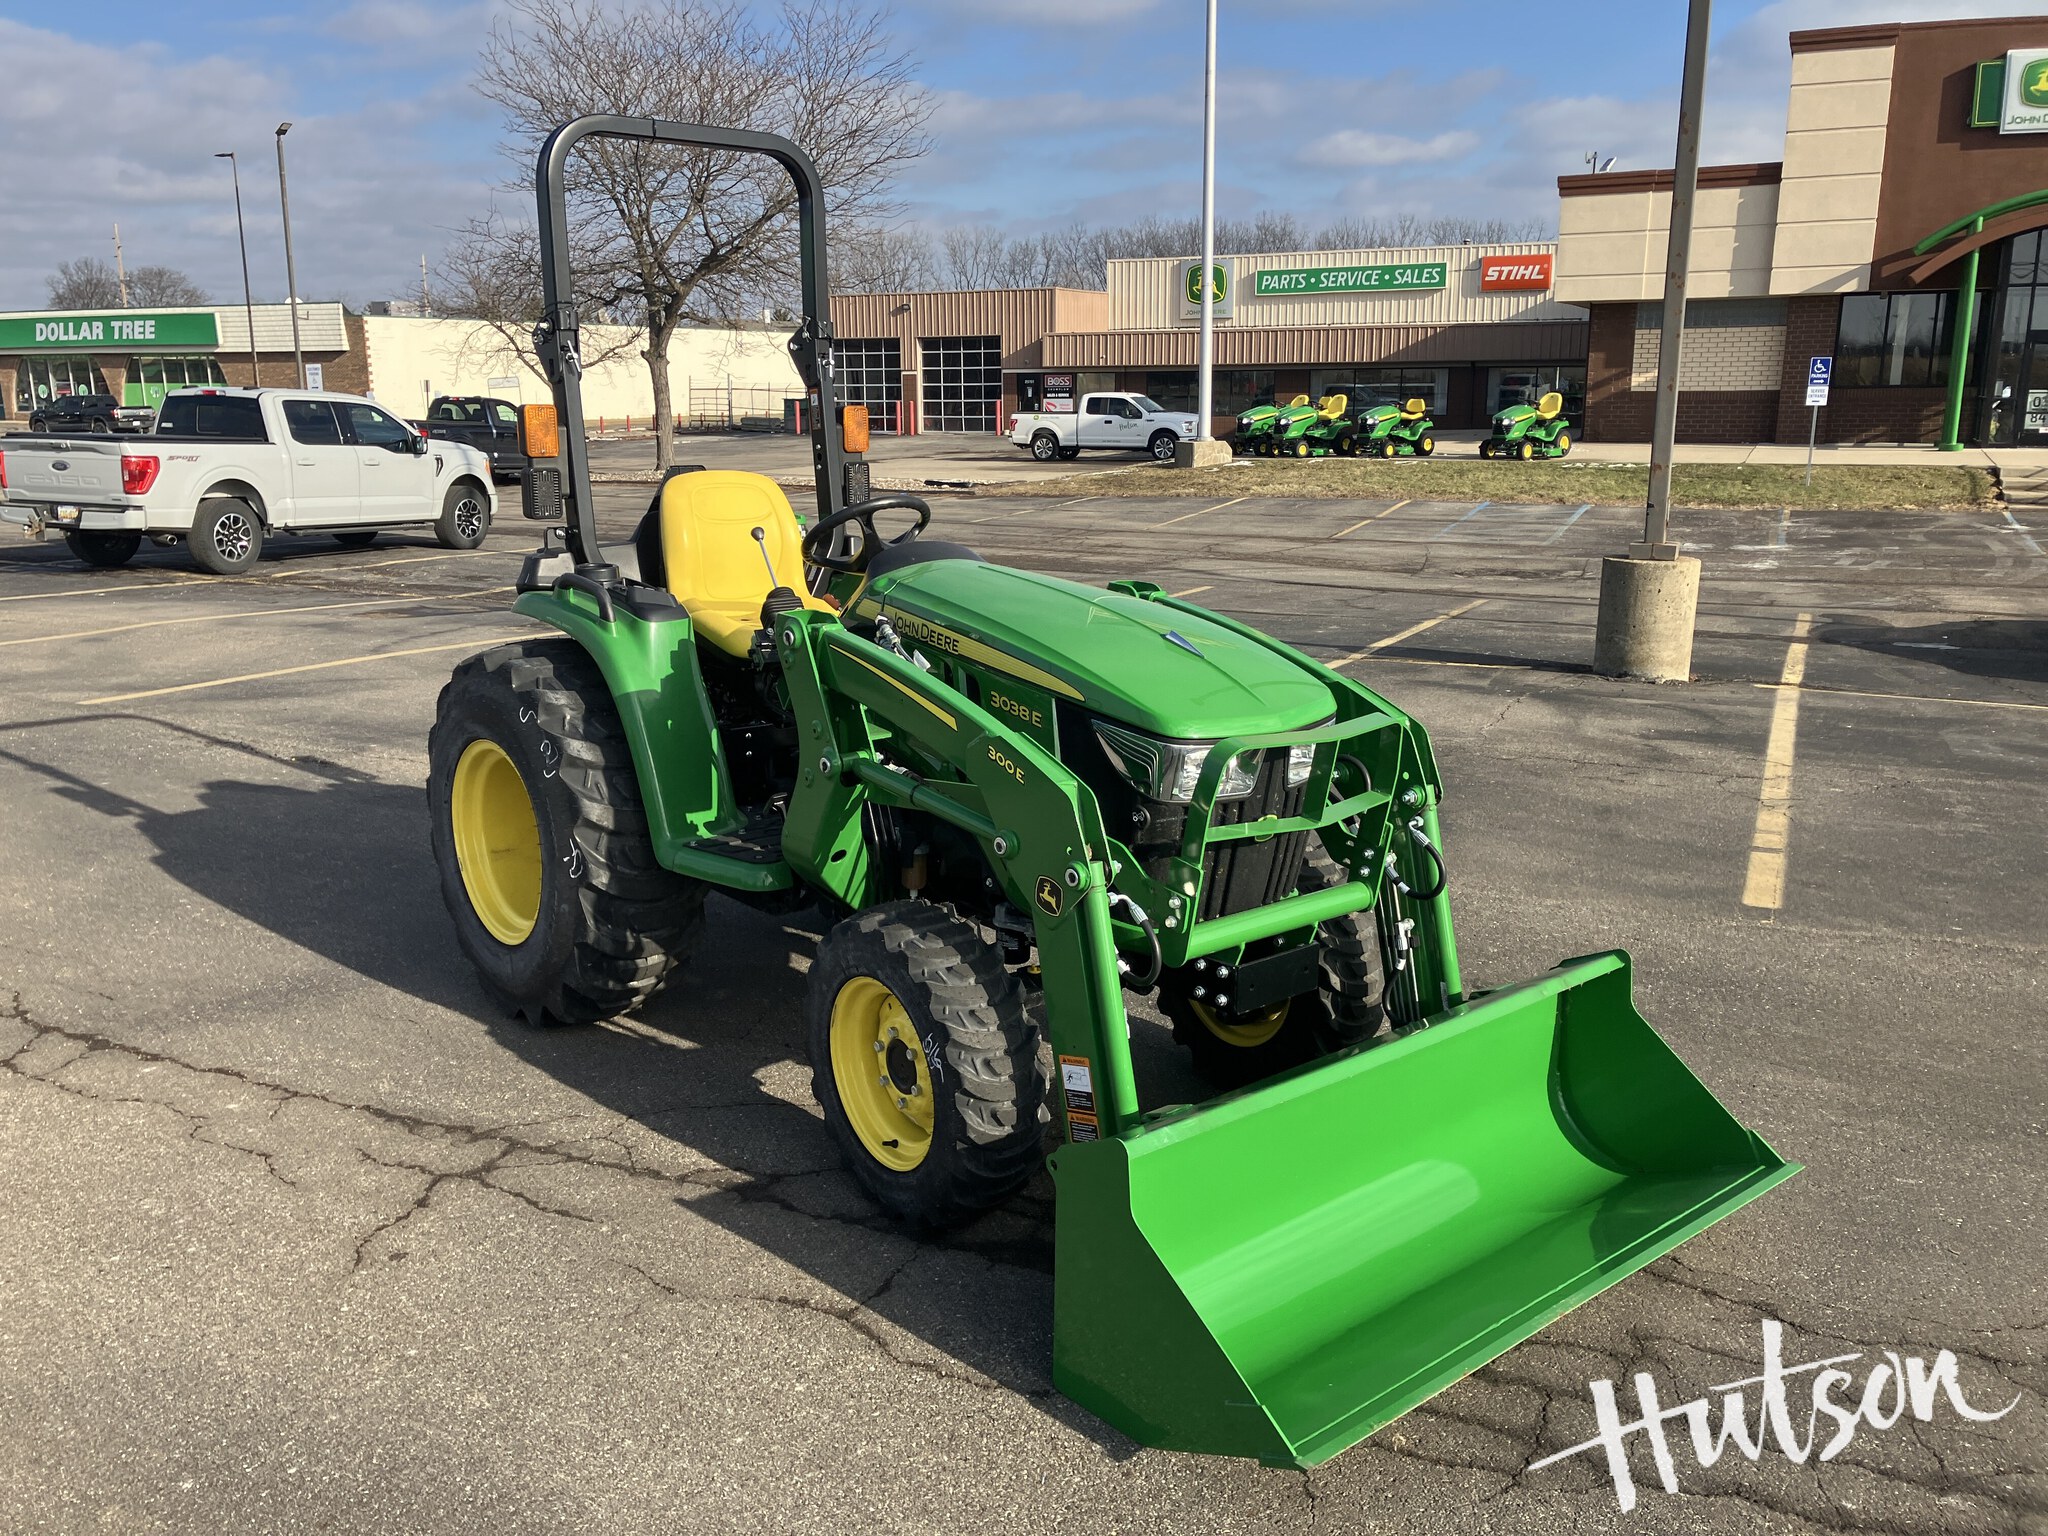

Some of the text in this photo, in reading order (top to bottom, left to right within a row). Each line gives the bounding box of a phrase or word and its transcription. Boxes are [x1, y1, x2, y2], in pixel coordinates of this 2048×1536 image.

[2007, 115, 2041, 125] JOHN
[1261, 267, 1441, 290] PARTS SERVICE SALES
[1484, 265, 1545, 281] STIHL
[35, 320, 155, 341] DOLLAR TREE
[1047, 377, 1070, 386] BOSS
[921, 622, 960, 653] DEERE
